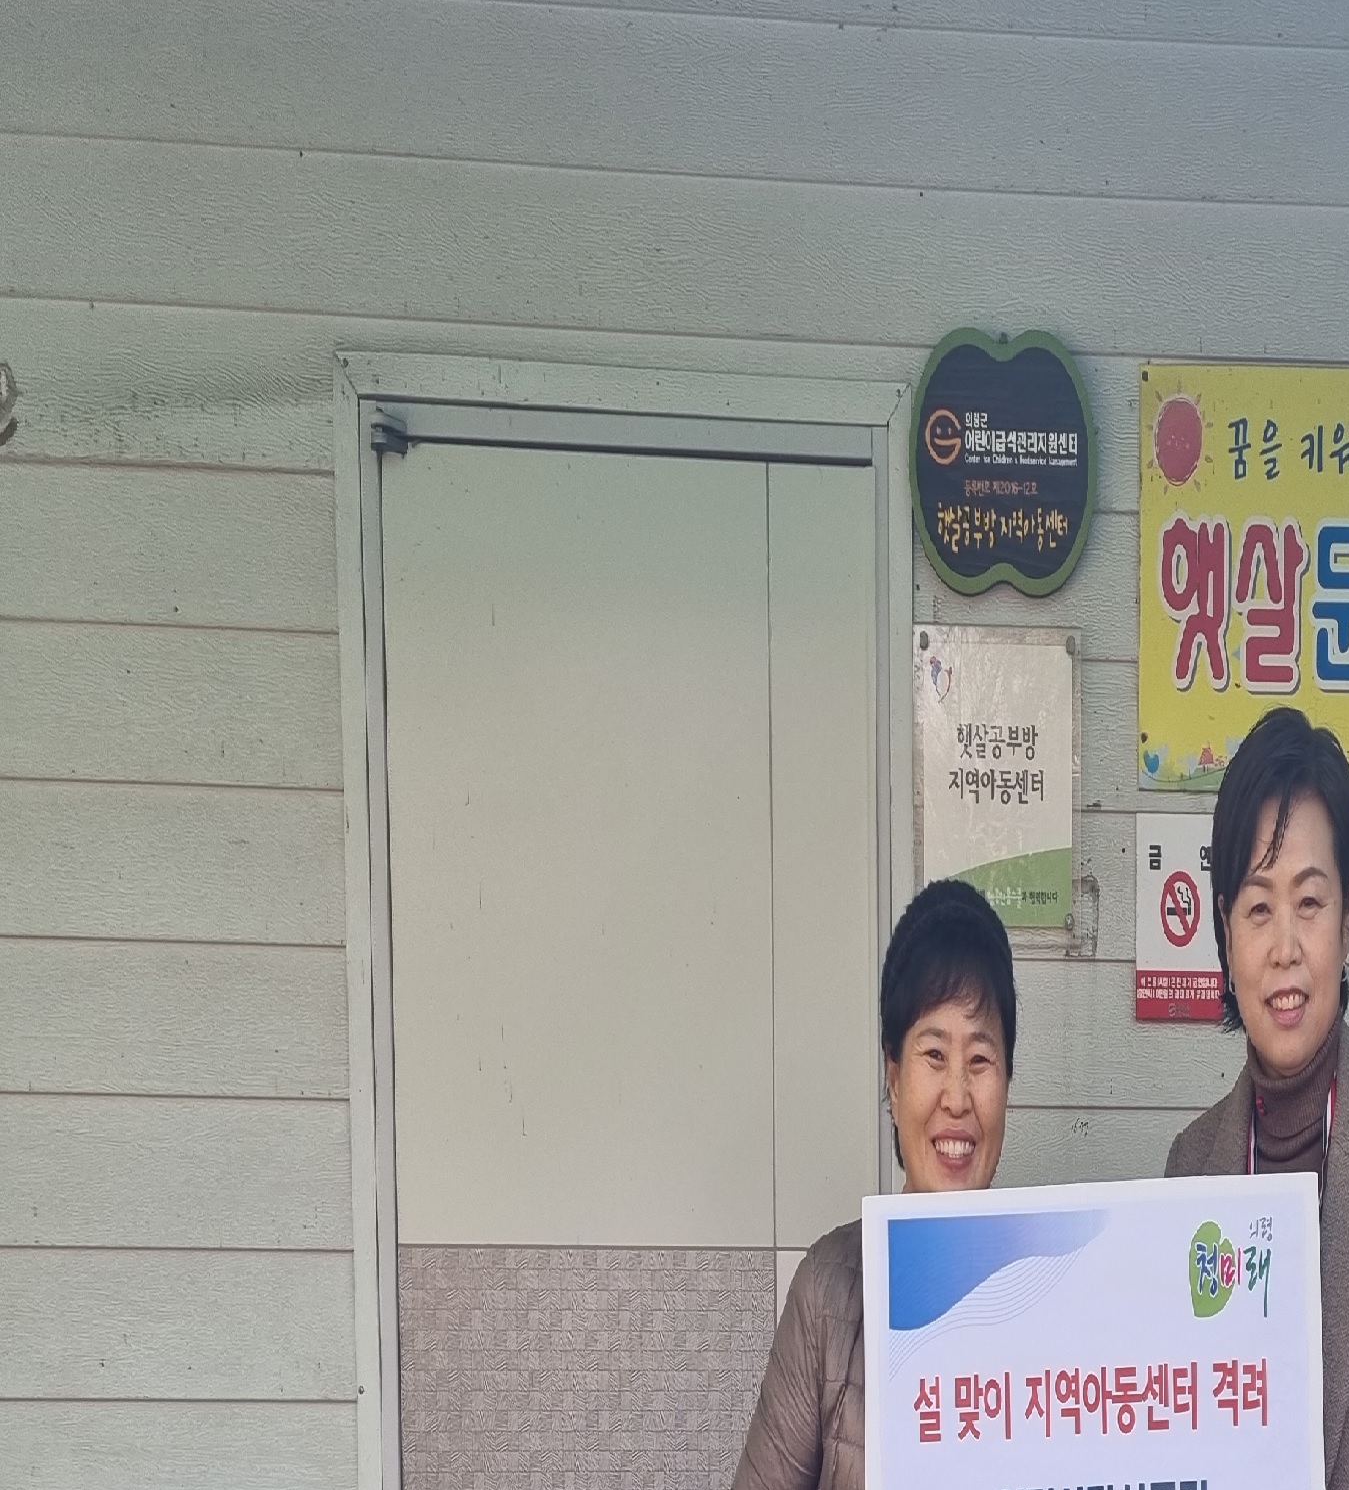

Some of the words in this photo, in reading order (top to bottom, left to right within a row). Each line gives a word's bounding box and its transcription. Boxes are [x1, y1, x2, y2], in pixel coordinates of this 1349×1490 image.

[965, 411, 988, 429] 의령군
[964, 430, 1078, 455] 어린이급식관리지원센터
[1227, 417, 1282, 480] 꿈을
[937, 502, 997, 554] 햇살공부방
[1000, 507, 1068, 553] 지역아동센터
[956, 724, 1038, 761] 햇살공부방
[948, 768, 1045, 805] 지역아동센터
[1148, 845, 1162, 871] 금
[1248, 1216, 1274, 1244] 의령
[1194, 1241, 1271, 1319] 청미래
[913, 1377, 942, 1443] 설
[954, 1370, 1012, 1441] 맞이
[1024, 1361, 1199, 1437] 지역아동센터
[1211, 1357, 1269, 1428] 격려
